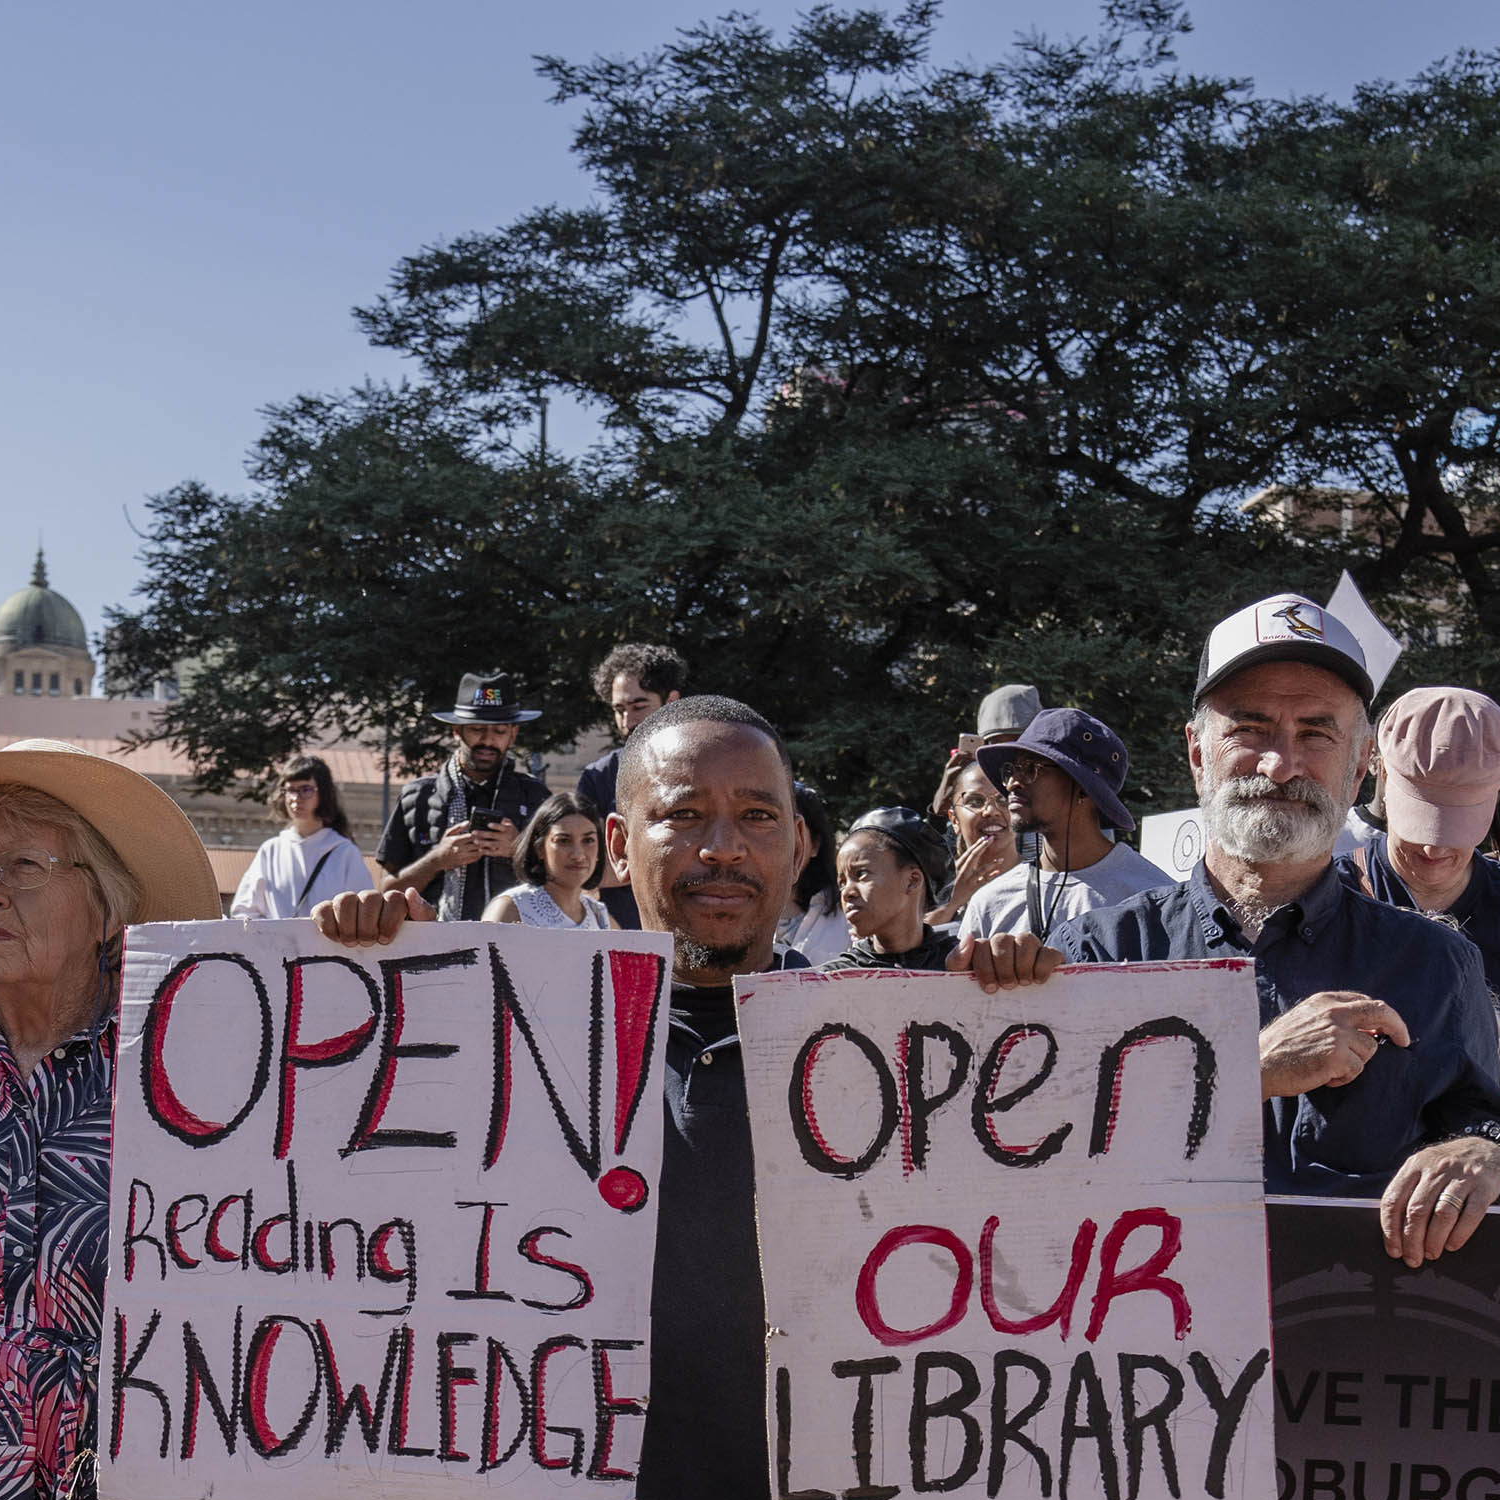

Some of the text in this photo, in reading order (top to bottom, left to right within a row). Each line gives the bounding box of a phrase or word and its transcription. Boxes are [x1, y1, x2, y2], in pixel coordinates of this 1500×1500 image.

[140, 942, 667, 1215] OPEN!
[122, 1159, 418, 1316] Reading
[855, 1207, 1192, 1346] OUR
[109, 1304, 649, 1481] KNOWLEDGE
[1275, 1370, 1363, 1427] VE
